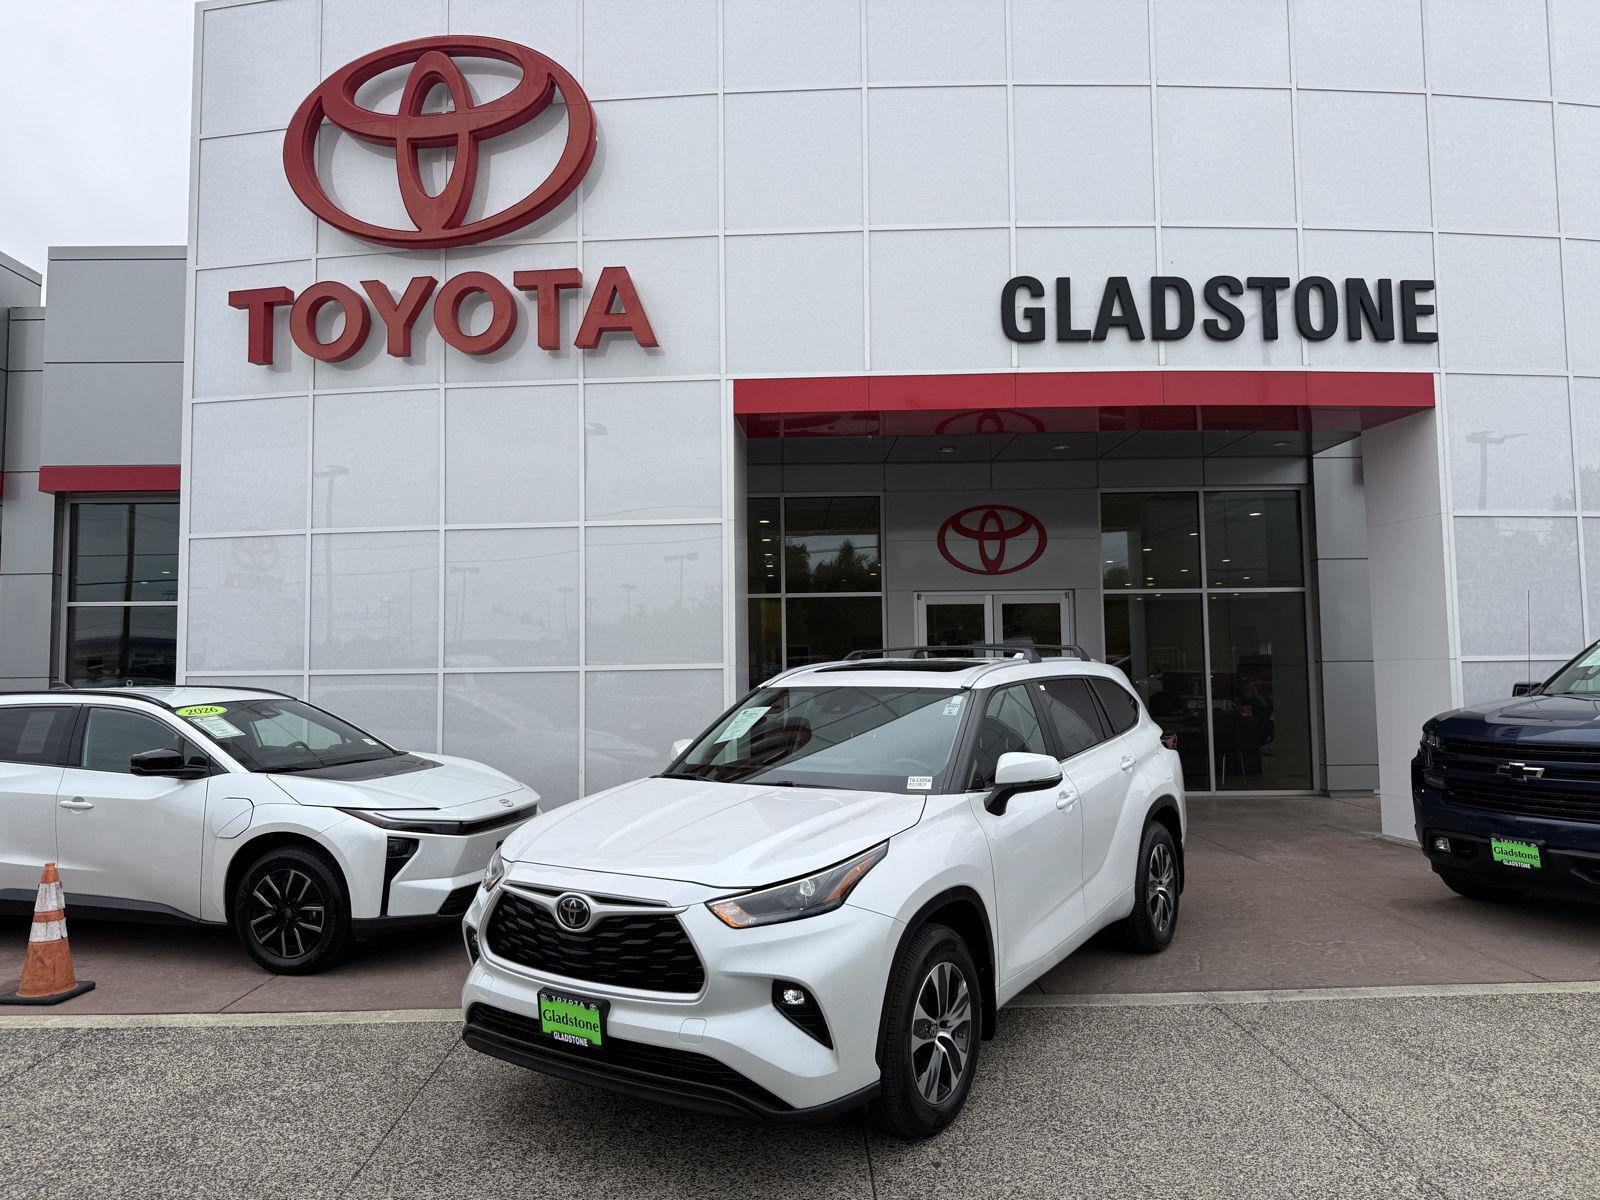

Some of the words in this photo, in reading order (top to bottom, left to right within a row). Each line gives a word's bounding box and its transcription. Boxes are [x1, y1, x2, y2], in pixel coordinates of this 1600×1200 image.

[228, 266, 661, 366] TOYOTA
[1000, 275, 1439, 344] GLADSTONE
[185, 706, 218, 716] 2026
[1493, 846, 1539, 861] Gladstone
[1502, 859, 1531, 869] GLADSTONE
[551, 995, 585, 1008] TOYOTA
[542, 1008, 599, 1032] Gladstone
[553, 1031, 588, 1047] GLADSTONE
